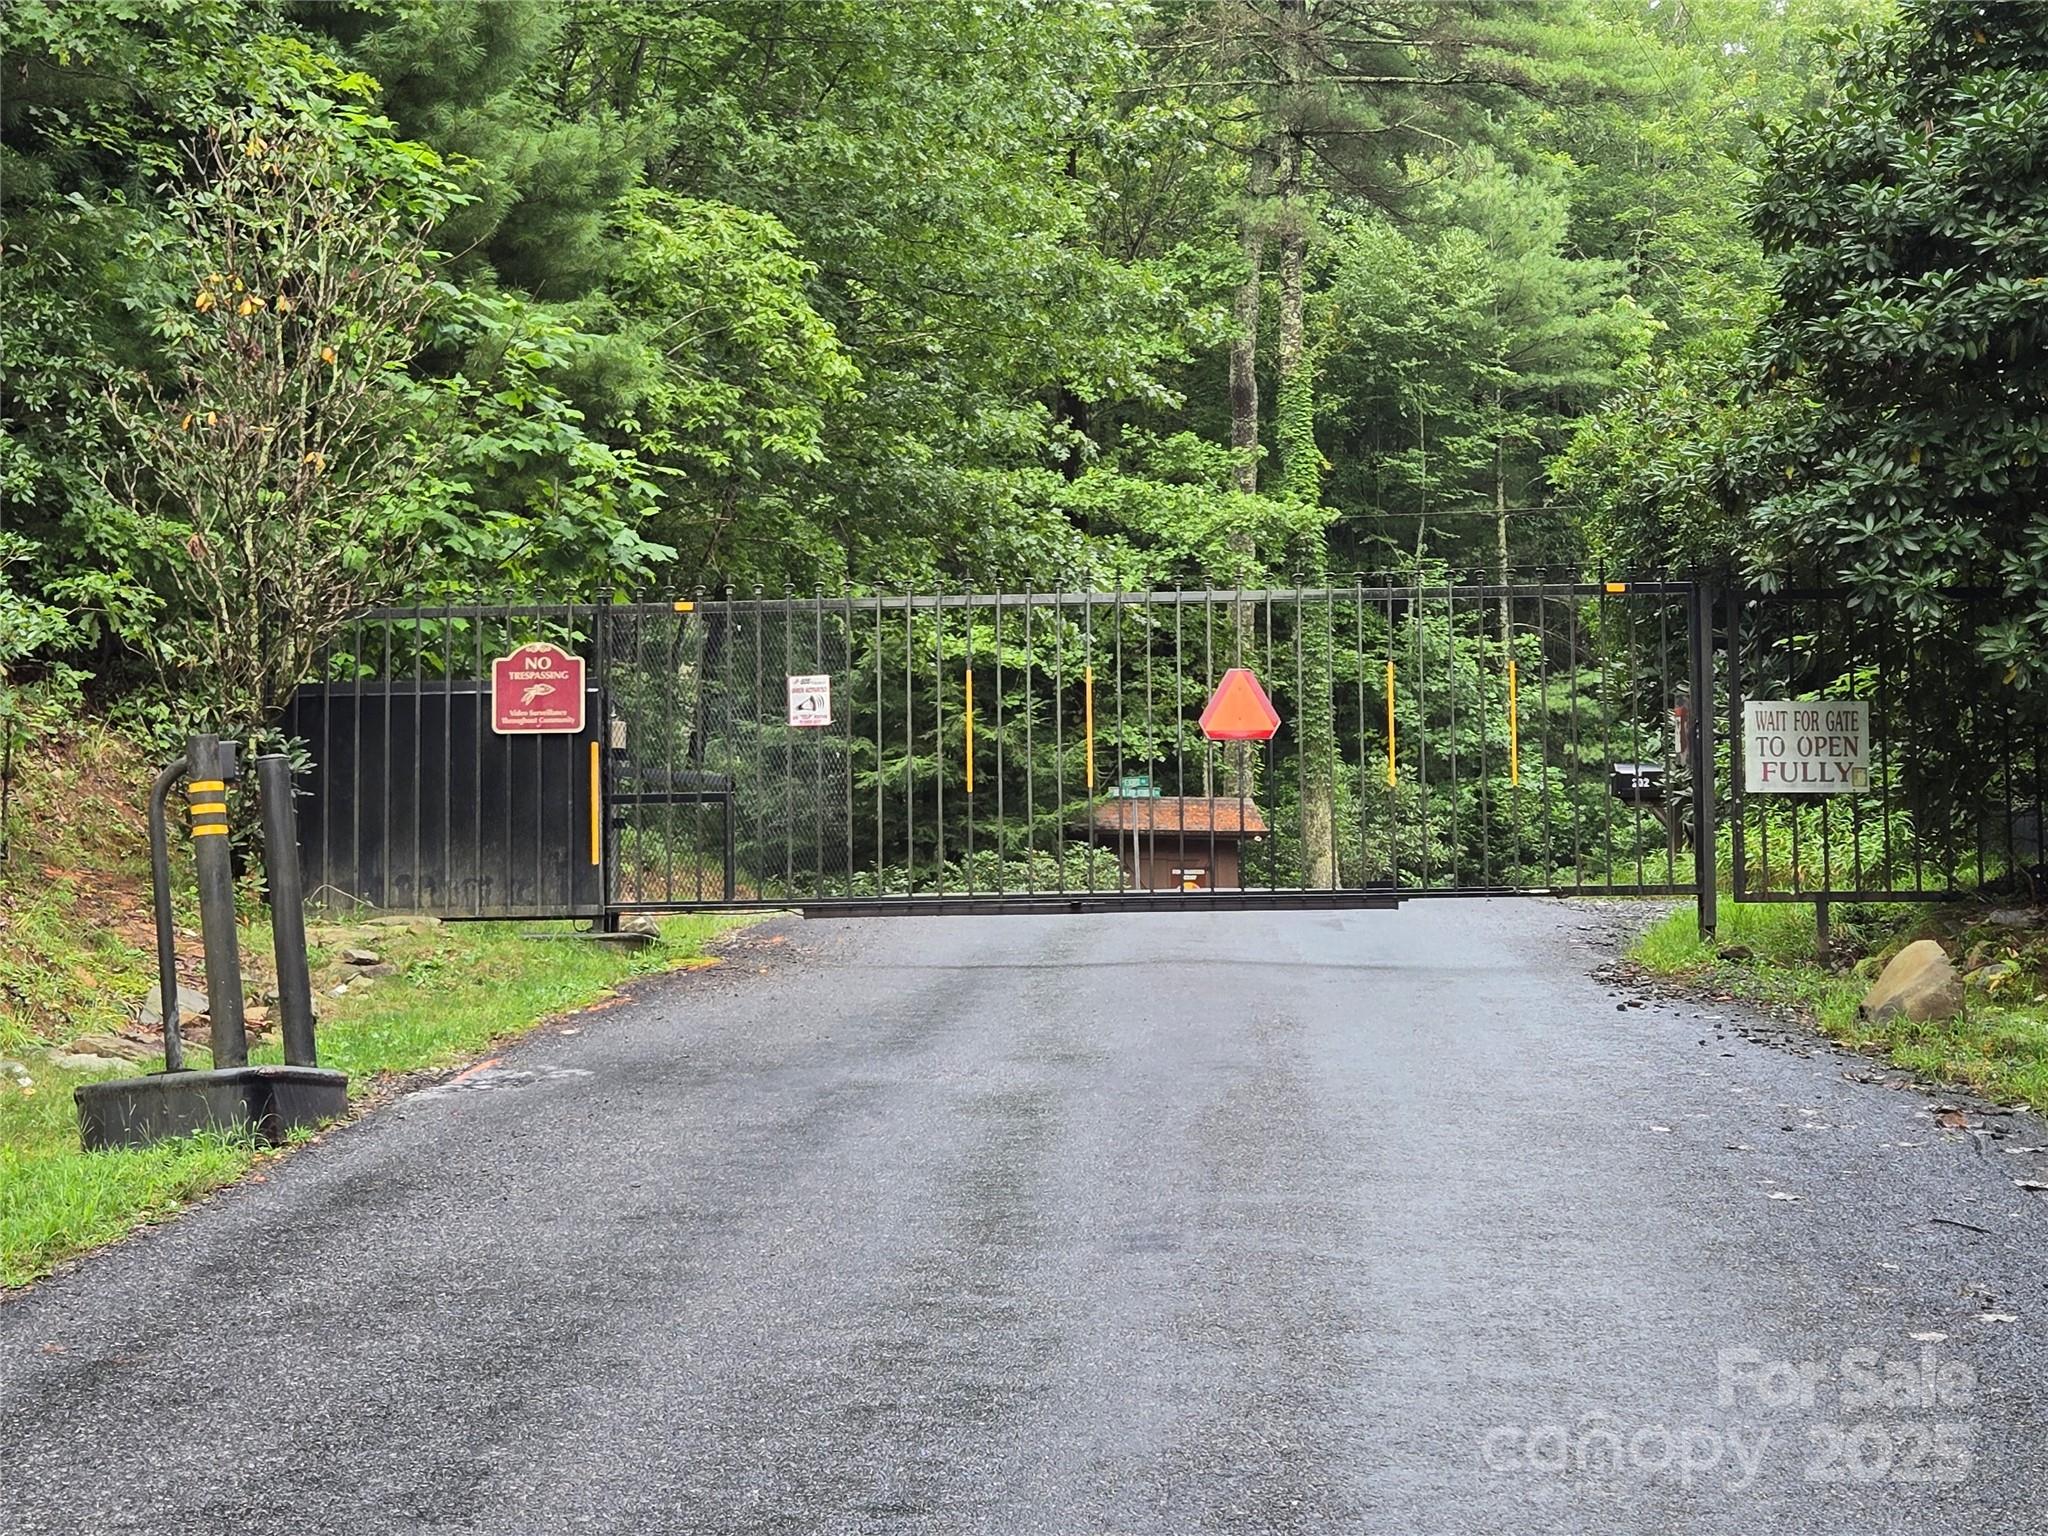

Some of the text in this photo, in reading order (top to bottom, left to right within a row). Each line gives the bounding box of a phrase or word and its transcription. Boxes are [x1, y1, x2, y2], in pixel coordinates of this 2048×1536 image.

[525, 657, 552, 670] NO
[508, 671, 569, 680] TRESPASSING
[1755, 710, 1860, 732] WAIT FOR GATE
[1756, 736, 1860, 757] TO OPEN
[1761, 761, 1855, 783] FULLY
